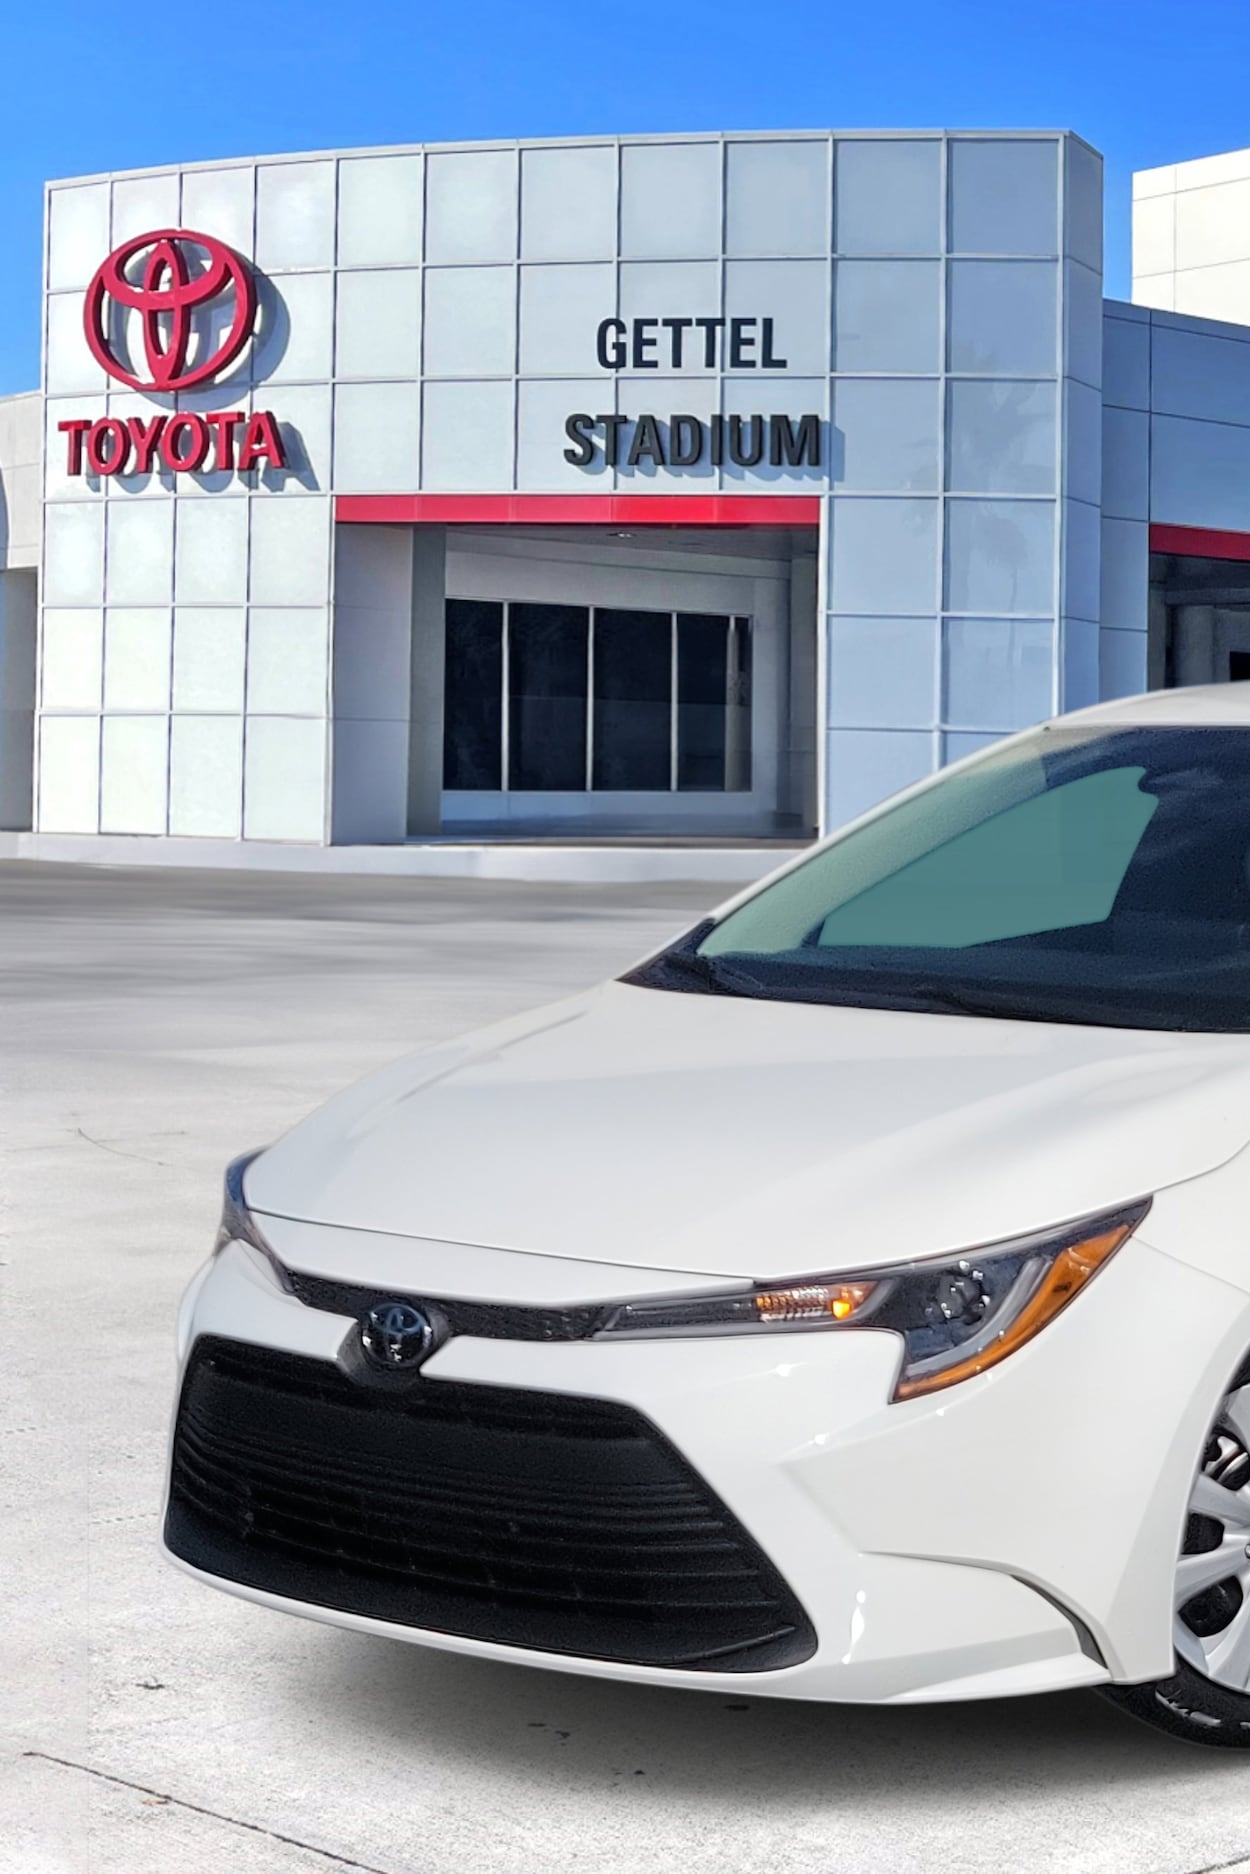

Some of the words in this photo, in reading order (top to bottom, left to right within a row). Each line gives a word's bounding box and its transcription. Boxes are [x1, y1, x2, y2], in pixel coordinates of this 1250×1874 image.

[596, 317, 788, 369] GETTEL
[58, 410, 286, 476] TOYOTA
[563, 413, 821, 467] STADIUM
